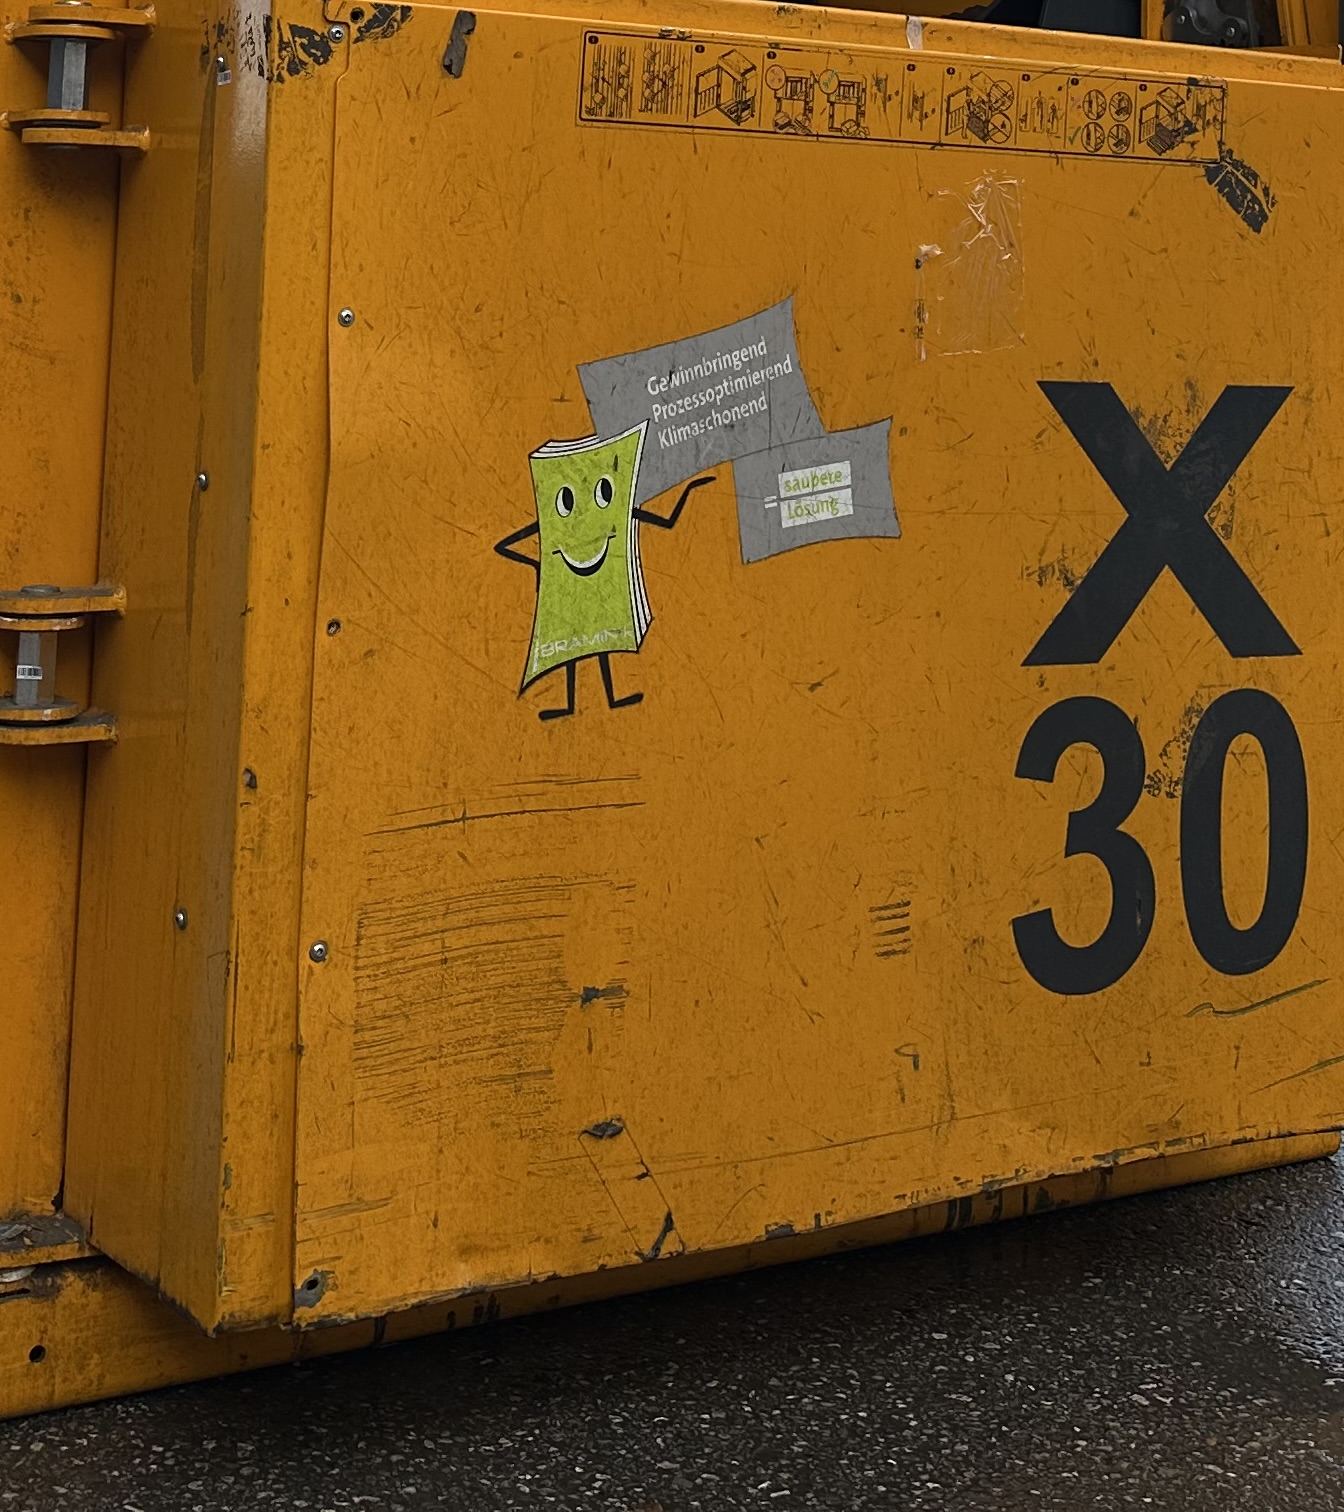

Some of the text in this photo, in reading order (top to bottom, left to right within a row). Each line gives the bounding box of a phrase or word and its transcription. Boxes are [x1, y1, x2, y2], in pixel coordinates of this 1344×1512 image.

[647, 335, 768, 395] Gewinnbringend
[652, 354, 793, 422] Prozessoptimierend
[657, 391, 768, 449] Klimaschonend
[784, 470, 843, 493] saubere
[787, 497, 840, 520] Lösung
[1020, 380, 1303, 667] X
[1011, 687, 1309, 996] 30
